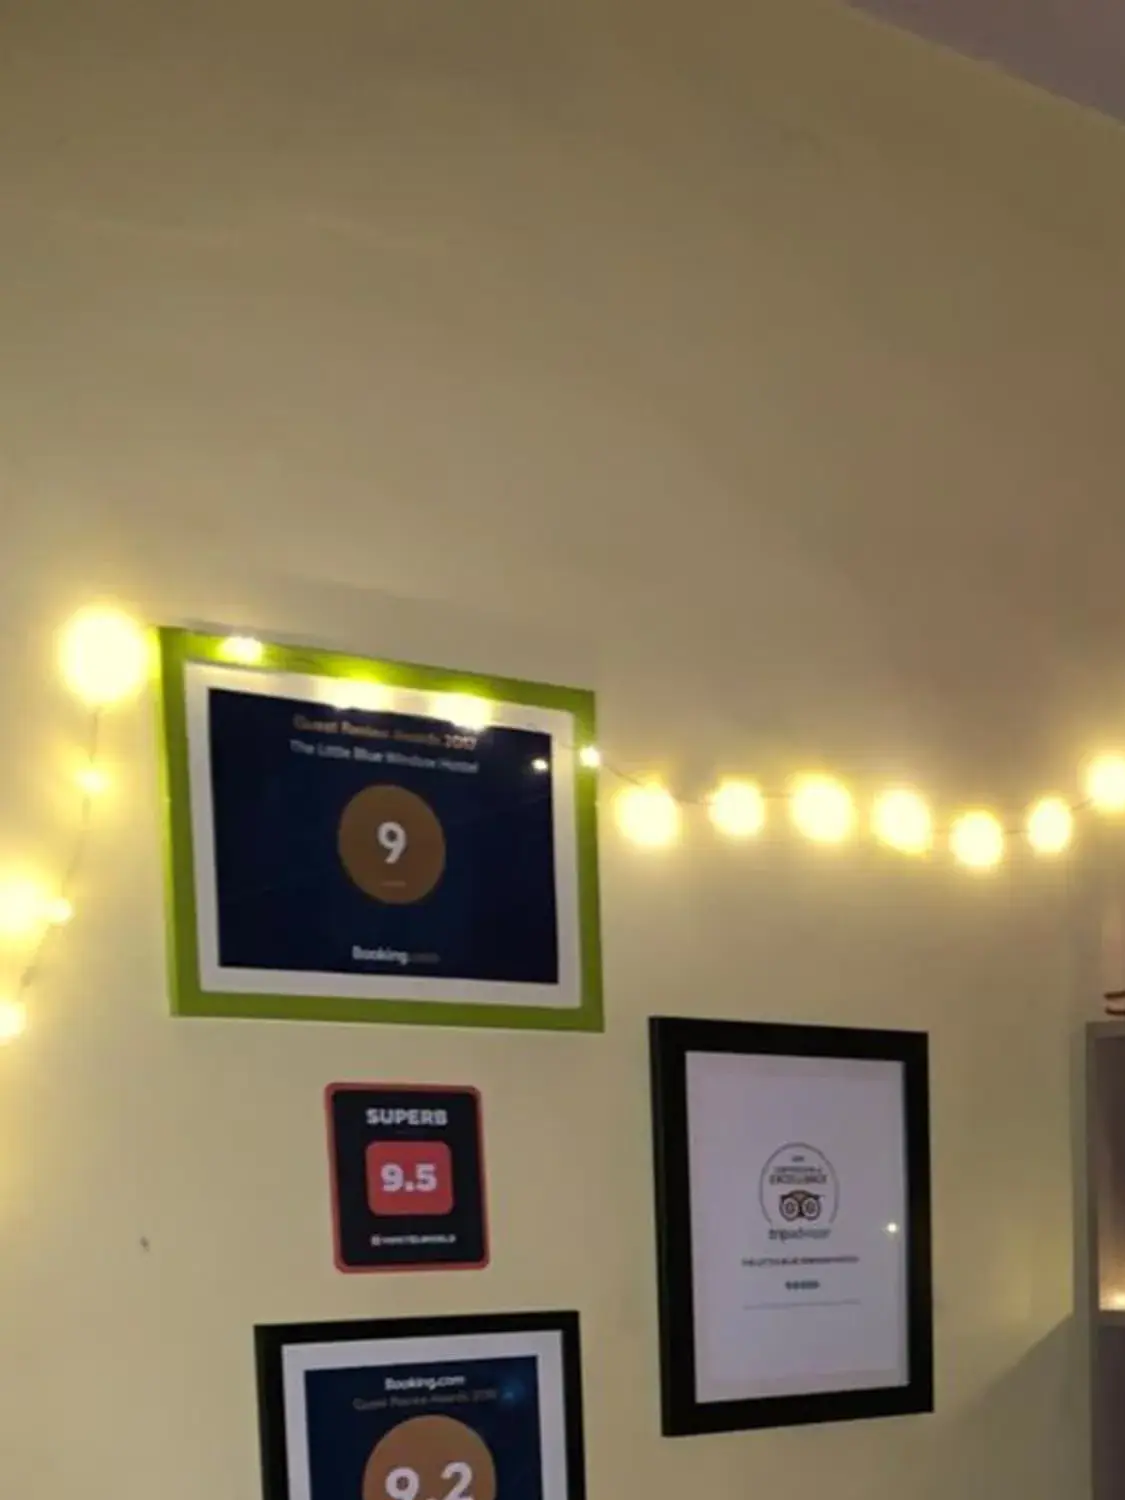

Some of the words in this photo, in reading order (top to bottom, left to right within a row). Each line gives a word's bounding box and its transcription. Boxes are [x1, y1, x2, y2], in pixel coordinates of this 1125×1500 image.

[289, 739, 315, 755] The
[317, 743, 350, 760] Little
[353, 746, 384, 763] Blue
[386, 751, 436, 769] Window
[376, 821, 407, 864] 9
[365, 1107, 448, 1126] SUPERB
[380, 1163, 437, 1192] 9.5
[384, 1375, 465, 1391] Booking.com
